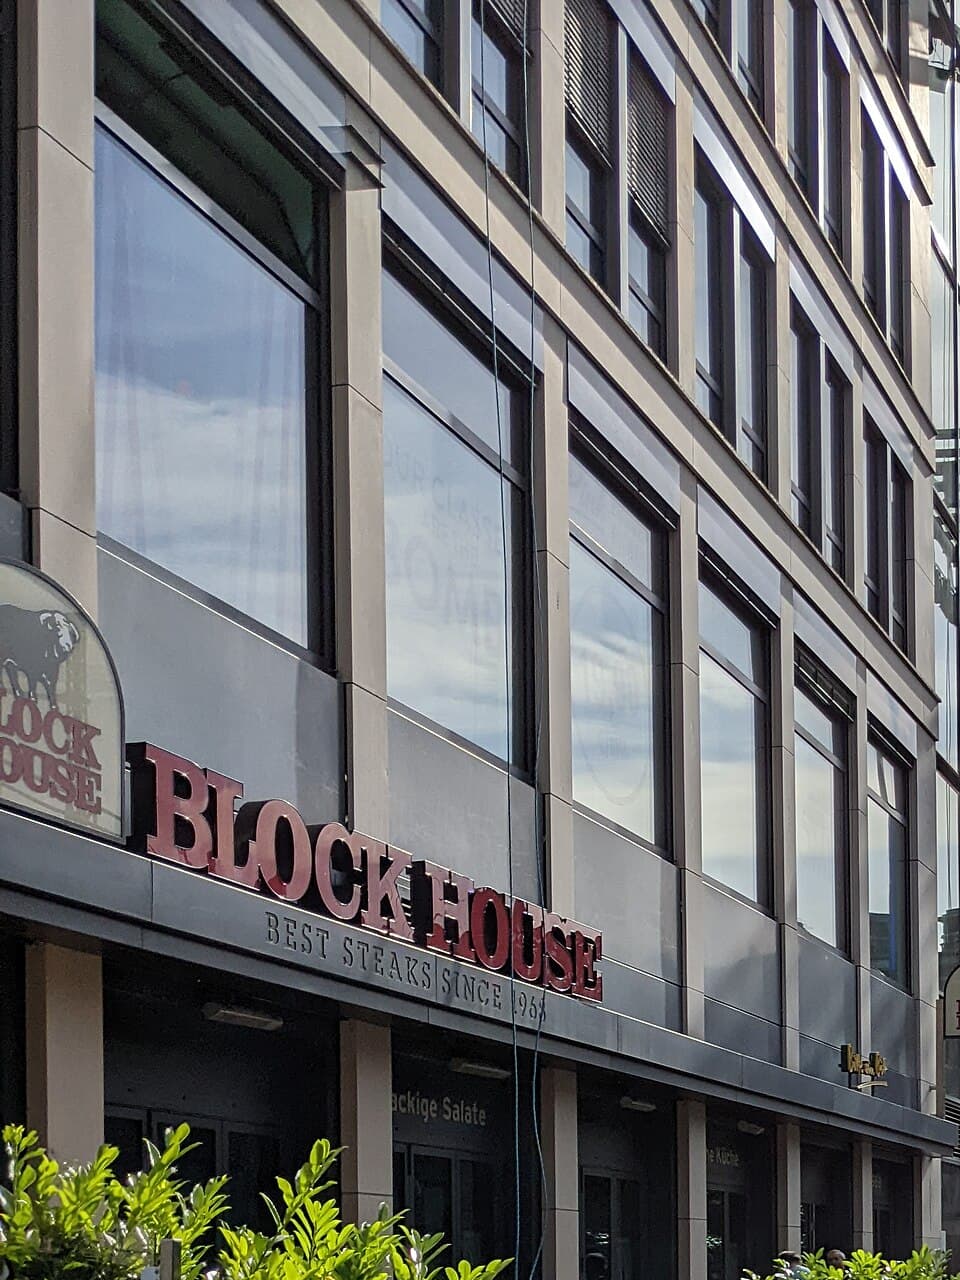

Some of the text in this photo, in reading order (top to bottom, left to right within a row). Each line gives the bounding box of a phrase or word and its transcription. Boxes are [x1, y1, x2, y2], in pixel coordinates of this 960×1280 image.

[145, 742, 603, 1004] BLOCK HOUSE
[264, 911, 331, 961] BEST
[342, 936, 432, 990] STEAKS
[441, 967, 502, 1010] SINCE
[442, 1096, 487, 1126] Salate
